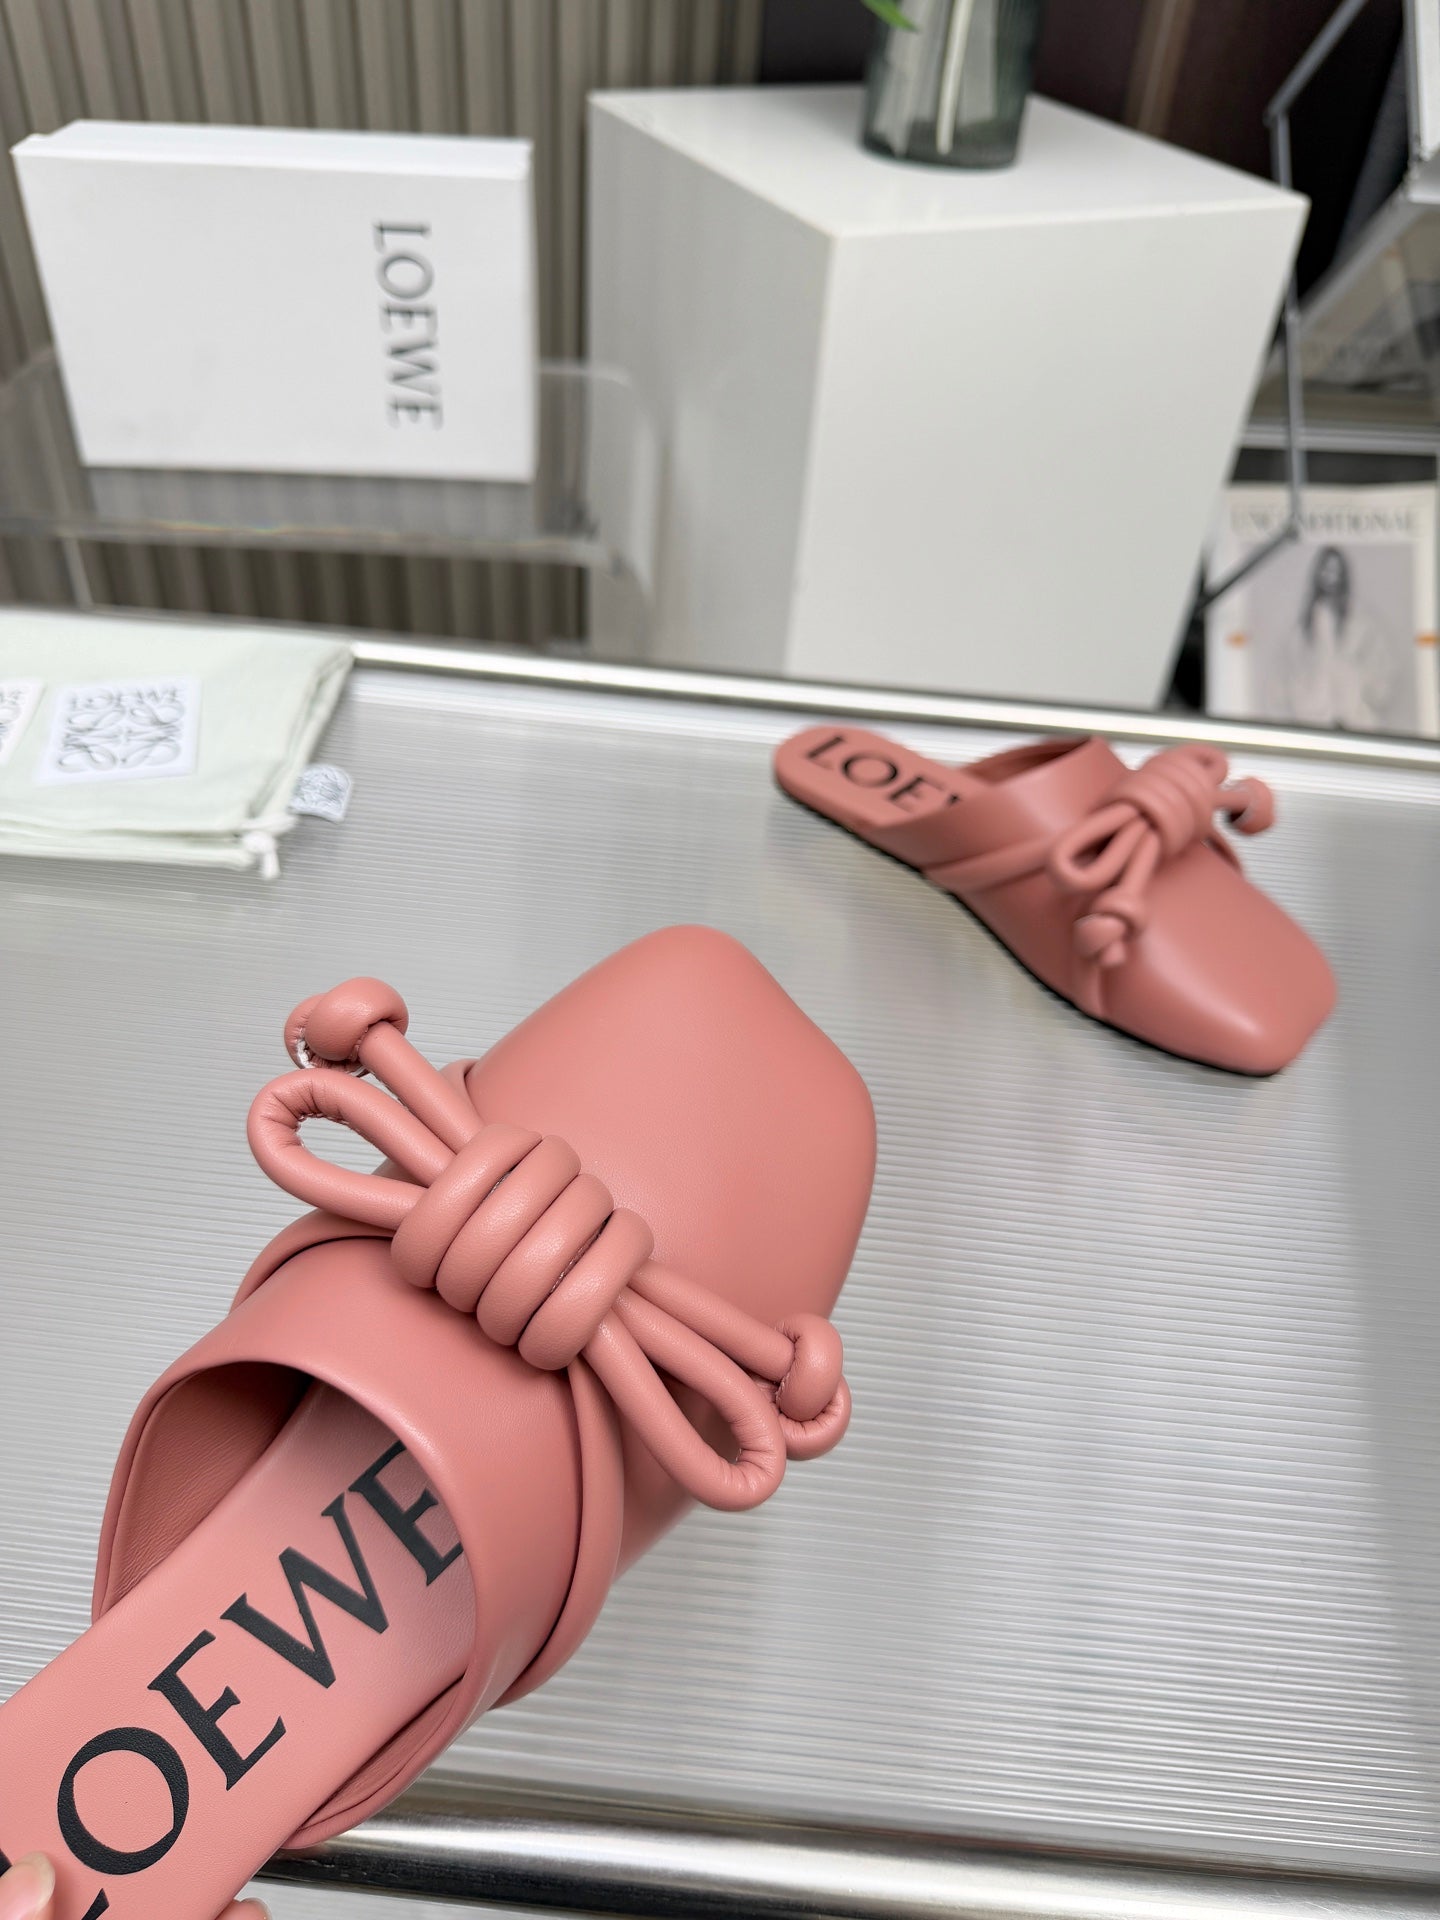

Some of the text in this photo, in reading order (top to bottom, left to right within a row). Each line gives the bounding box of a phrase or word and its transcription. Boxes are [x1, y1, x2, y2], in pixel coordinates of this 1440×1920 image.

[372, 219, 443, 430] LOEWE
[807, 734, 960, 814] LOE
[0, 1439, 464, 1920] OEWE
